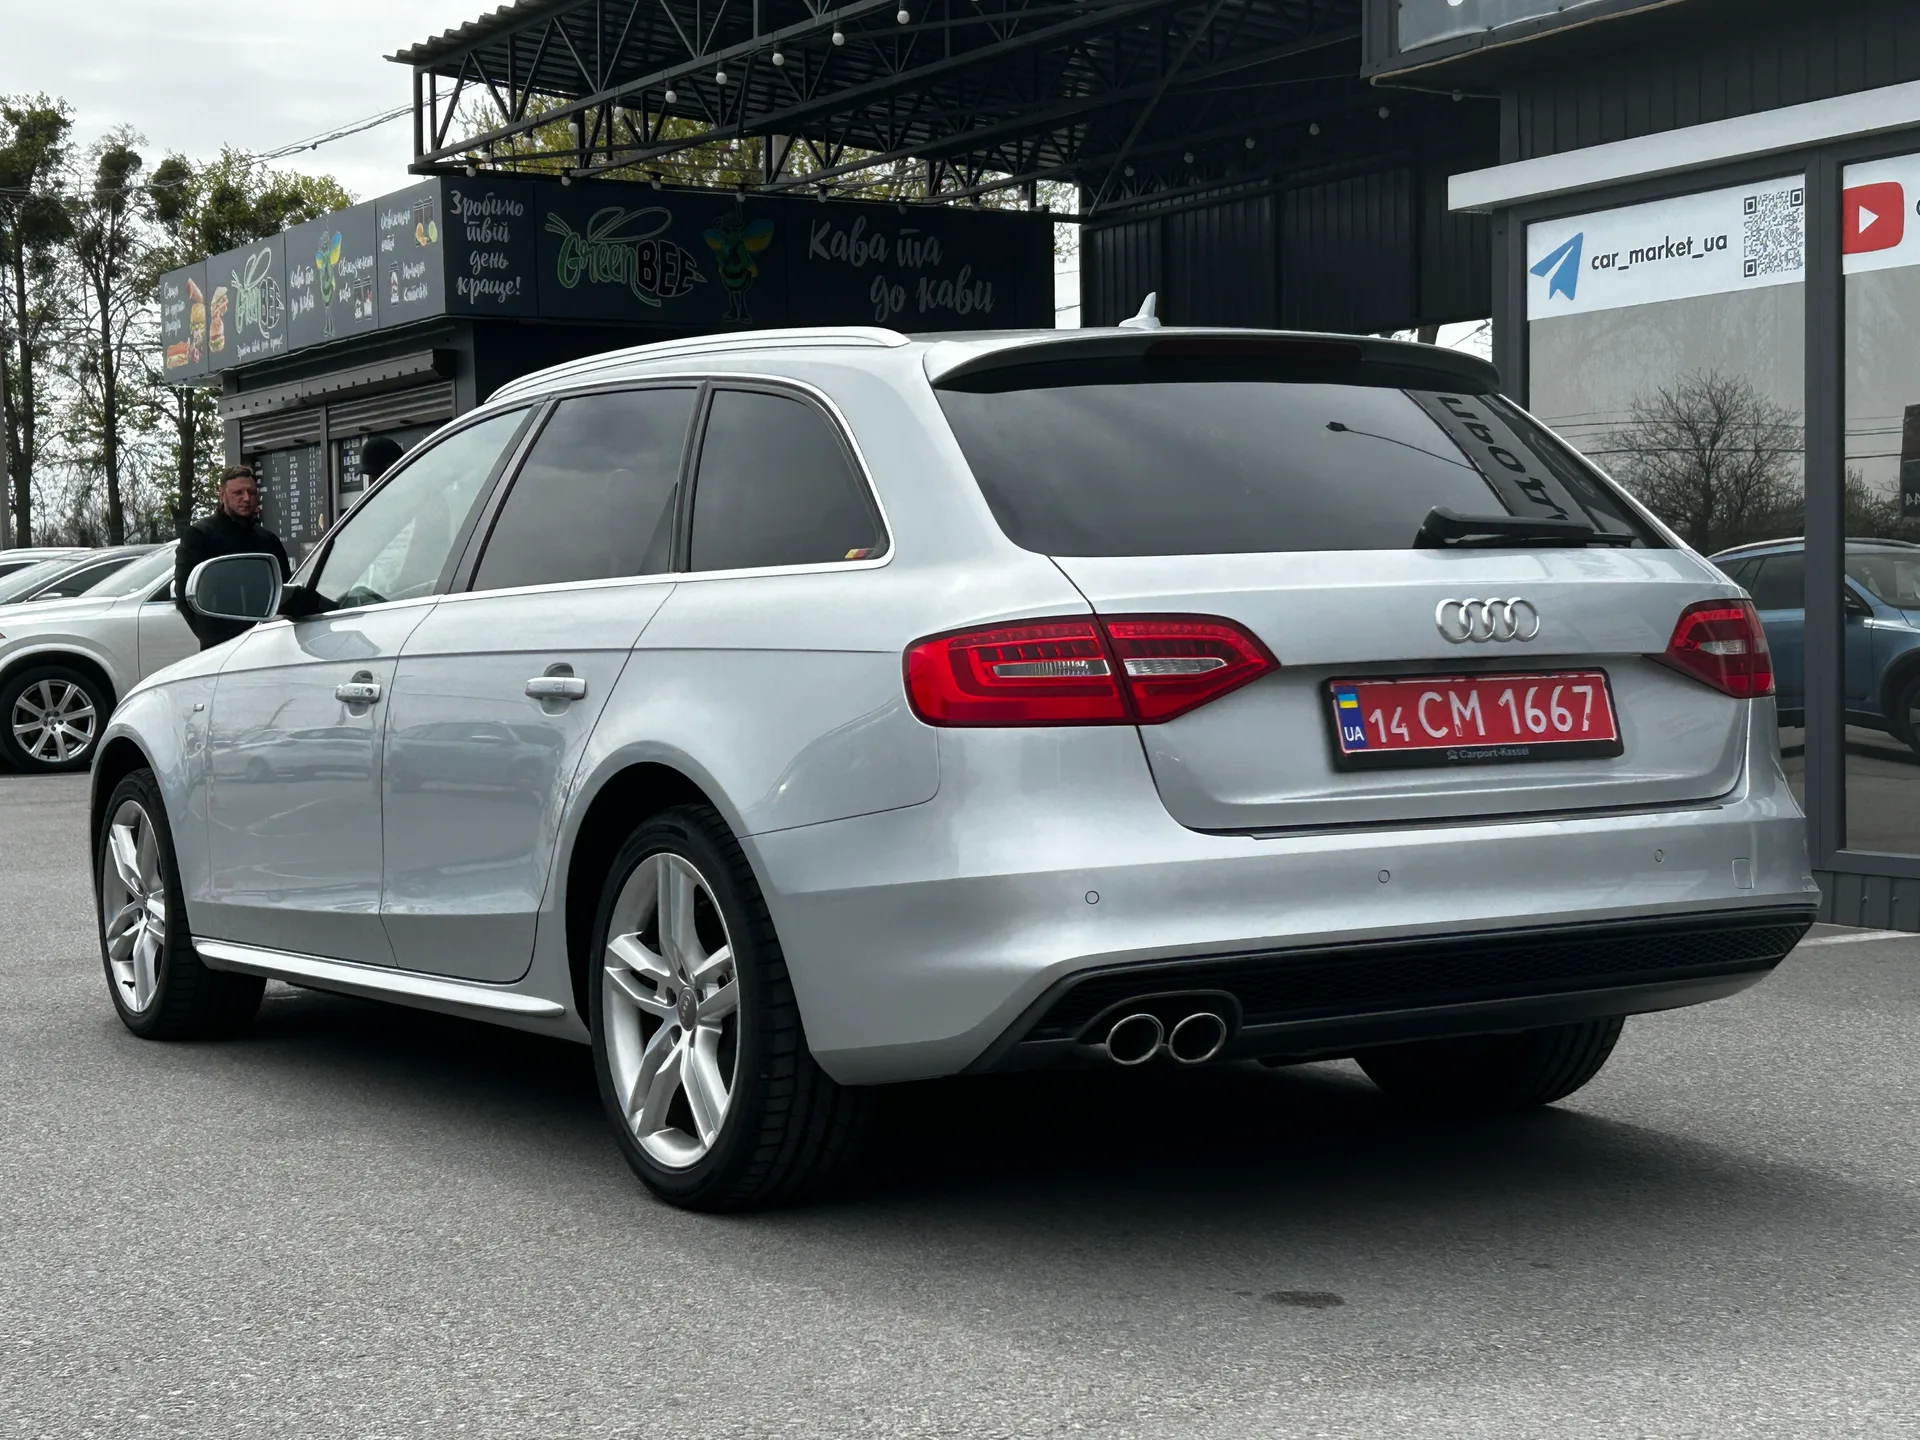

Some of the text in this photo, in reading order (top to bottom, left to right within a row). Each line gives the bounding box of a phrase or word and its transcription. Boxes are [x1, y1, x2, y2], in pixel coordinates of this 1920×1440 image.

[450, 190, 524, 224] Зробимо
[466, 217, 511, 243] твій
[808, 215, 943, 269] Кава та
[469, 250, 510, 275] день
[1590, 234, 1728, 271] car_market_ua
[456, 276, 522, 304] краще!
[869, 264, 996, 322] до кави
[1368, 684, 1594, 743] 14 CM 1667
[1344, 726, 1365, 742] UA
